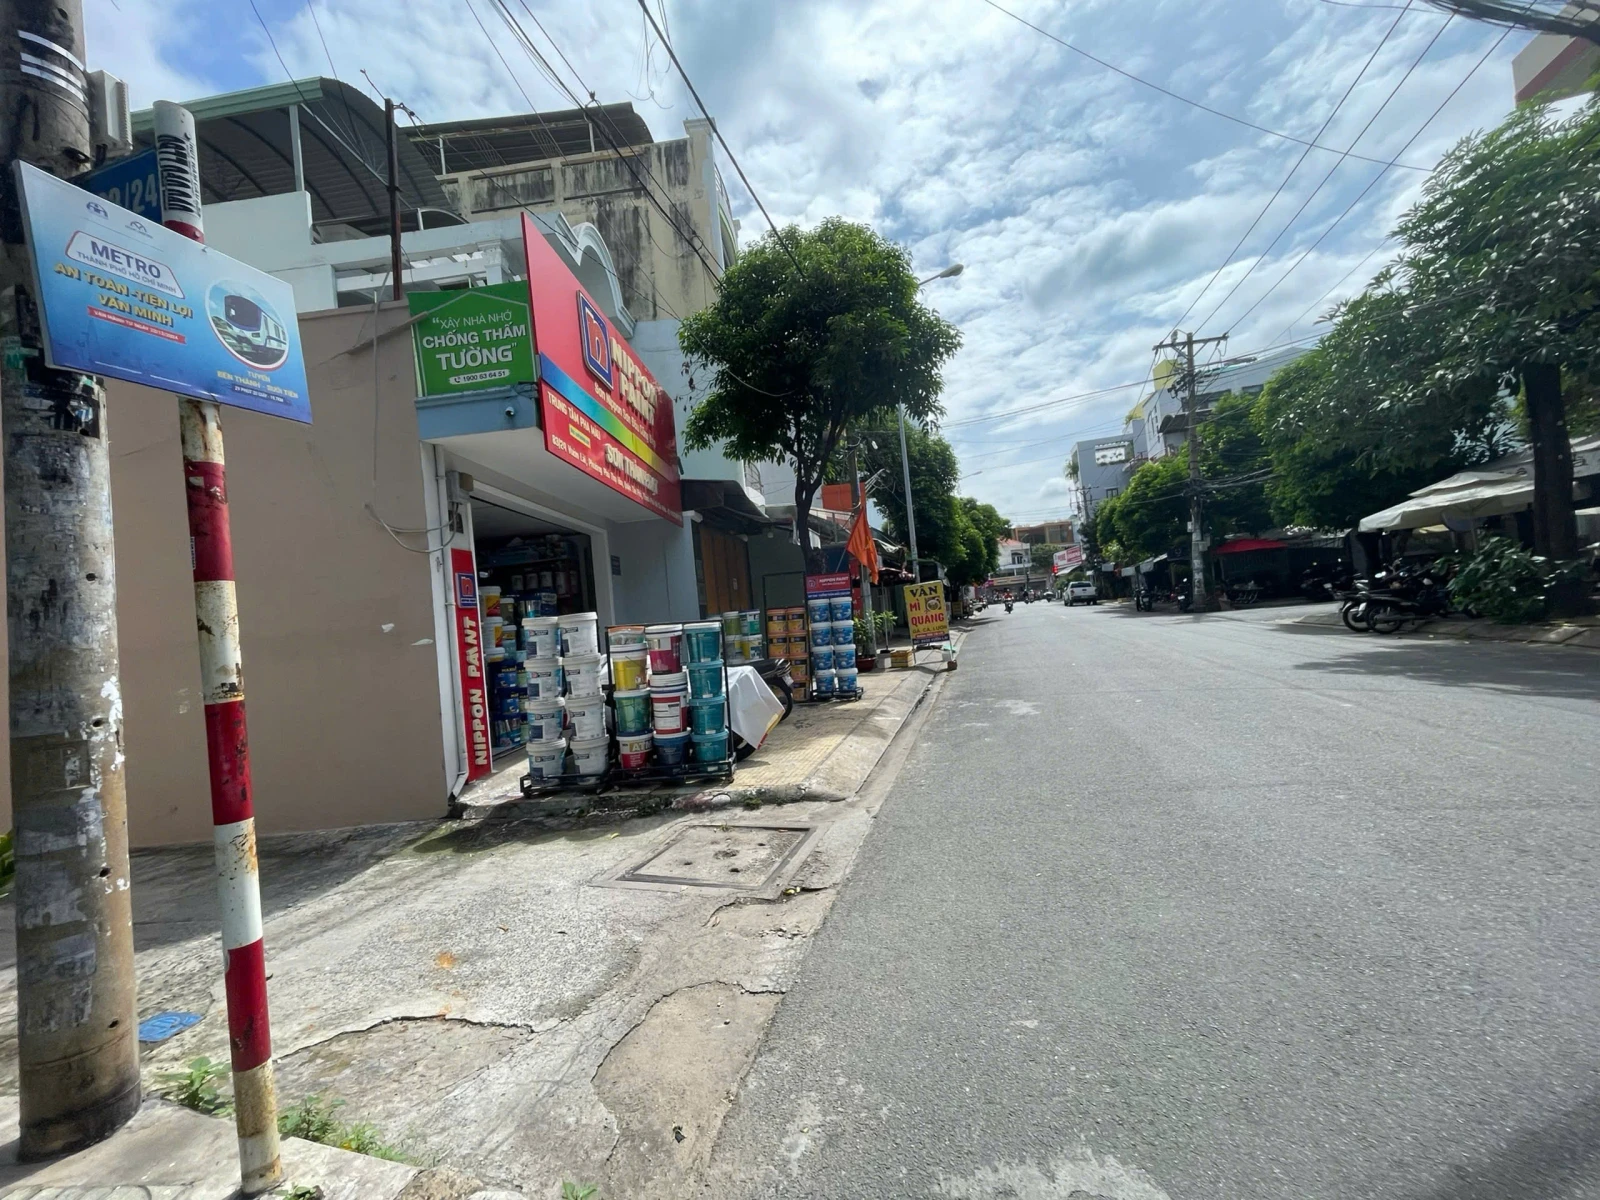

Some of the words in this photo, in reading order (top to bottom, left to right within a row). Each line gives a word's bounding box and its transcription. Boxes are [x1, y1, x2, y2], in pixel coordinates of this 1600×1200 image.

[76, 250, 108, 267] THÀNH
[91, 240, 161, 279] METRO
[54, 262, 81, 281] AN
[84, 270, 129, 296] TOÀN
[134, 306, 174, 328] MINH
[463, 313, 486, 327] NHÀ
[422, 329, 480, 349] CHỐNG
[482, 321, 527, 342] THẤM
[463, 373, 478, 382] 1900
[488, 371, 497, 379] 64
[610, 337, 657, 407] NIPPON
[547, 390, 568, 416] TRUNG
[619, 370, 656, 426] PAINT
[909, 585, 938, 598] VÂN
[909, 598, 921, 612] MÌ
[911, 610, 945, 627] QUẢNG
[469, 688, 488, 766] NIPPON
